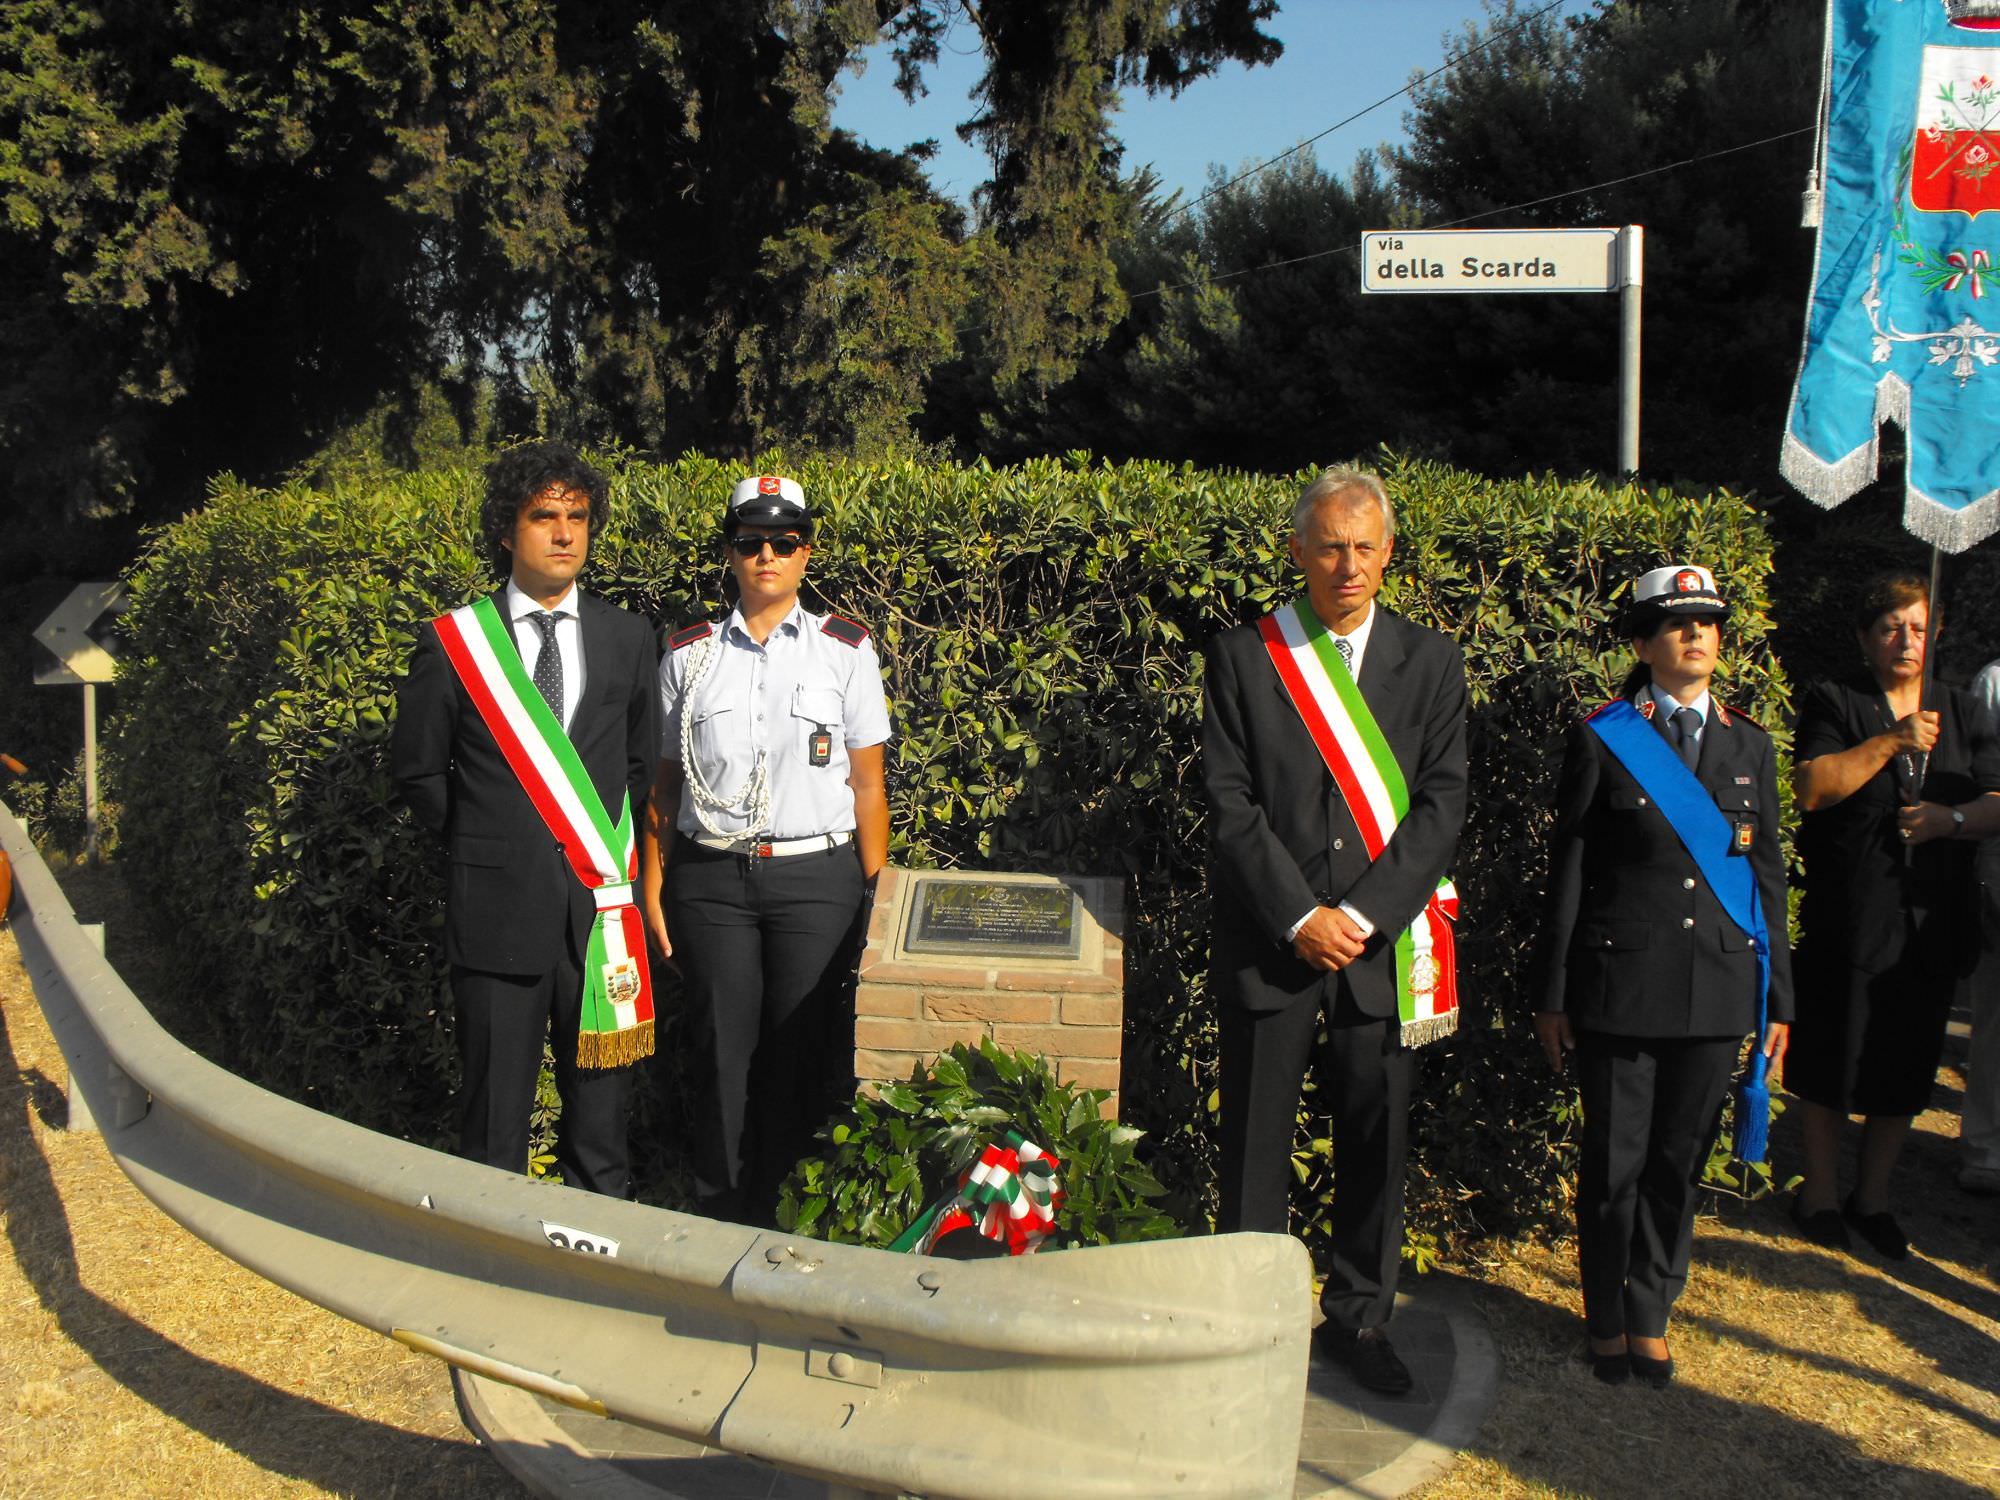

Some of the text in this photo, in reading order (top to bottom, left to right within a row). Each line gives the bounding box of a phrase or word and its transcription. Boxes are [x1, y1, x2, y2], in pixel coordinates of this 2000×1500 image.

[1378, 237, 1404, 251] via
[1377, 256, 1557, 279] della Scarda
